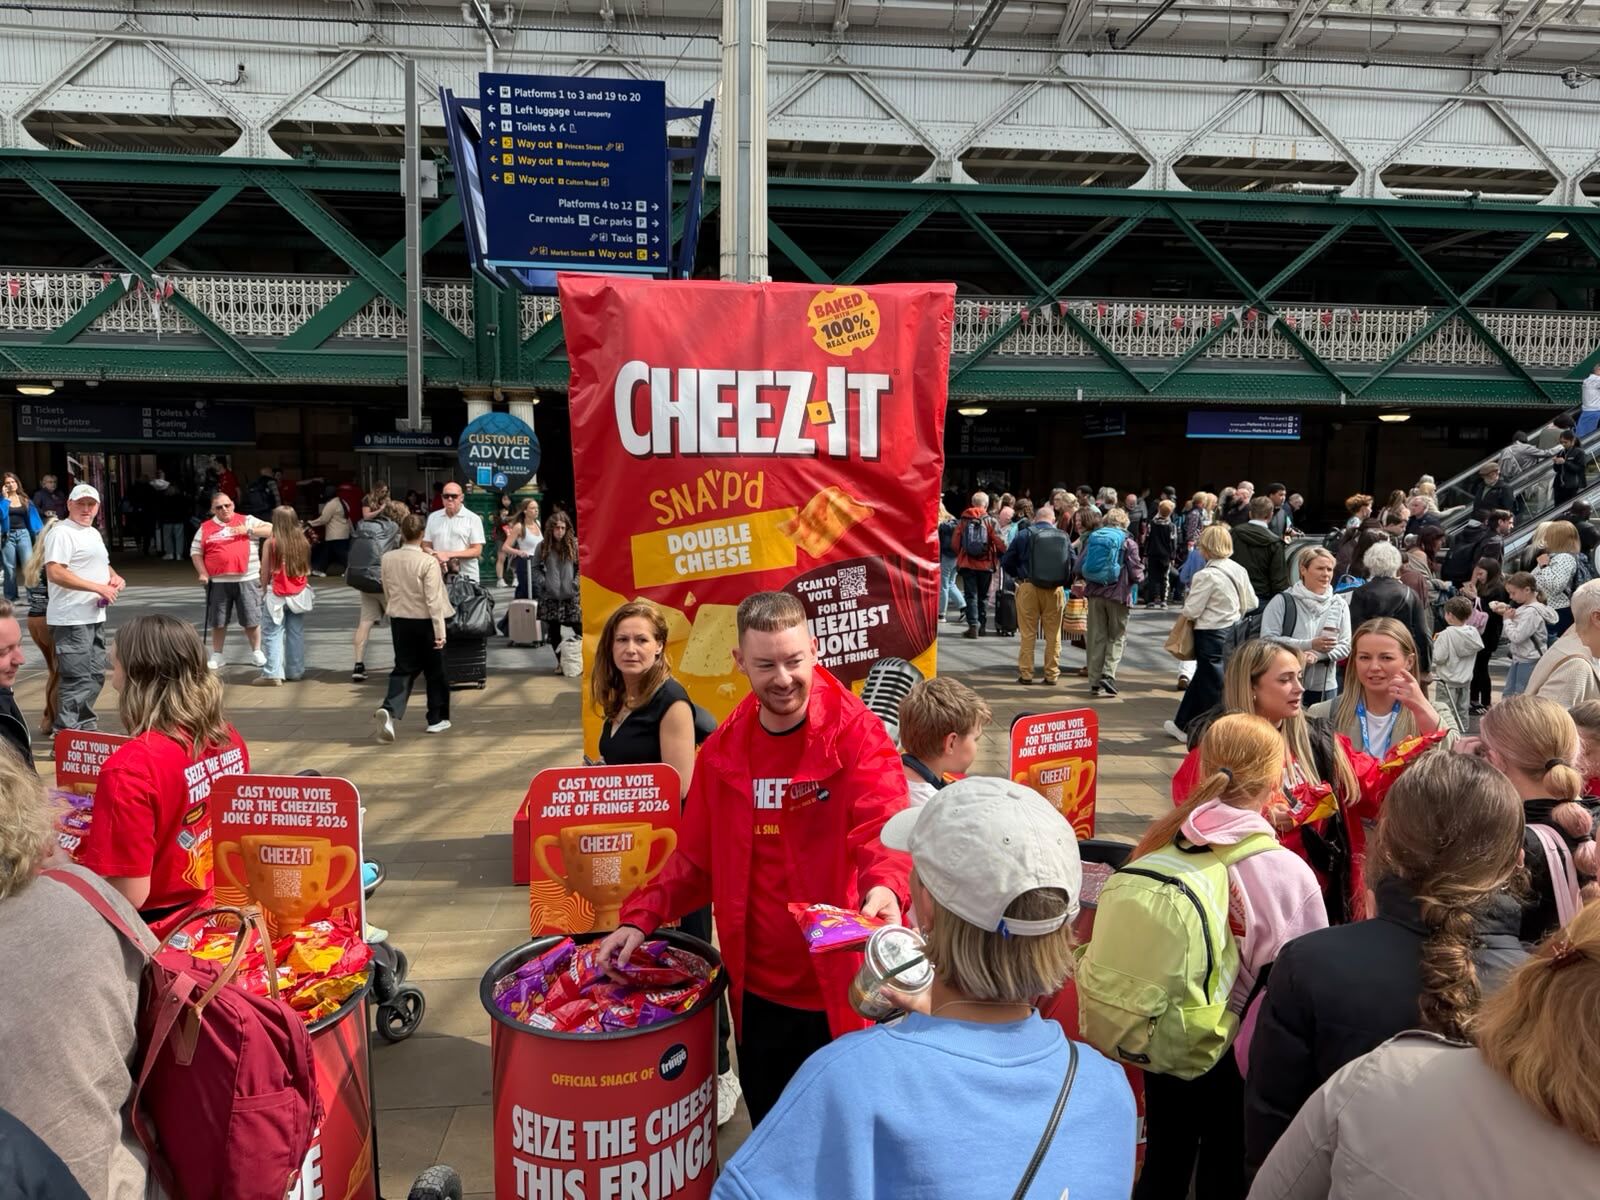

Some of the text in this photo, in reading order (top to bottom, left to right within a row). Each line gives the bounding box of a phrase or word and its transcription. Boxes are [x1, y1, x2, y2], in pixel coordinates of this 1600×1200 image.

[514, 88, 641, 102] Platforms 1 to 3 and 19 to 20
[515, 106, 533, 114] Left
[535, 106, 570, 117] luggage
[516, 122, 546, 131] Toilets
[517, 139, 536, 150] Way
[538, 141, 552, 149] out
[518, 156, 536, 166] Way
[566, 160, 590, 168] Waverley
[518, 175, 538, 185] Way
[559, 199, 632, 210] Platforms 4 to 12
[529, 214, 543, 223] Car
[545, 214, 575, 224] rentals
[593, 216, 608, 225] Car
[610, 217, 632, 227] parks
[611, 233, 633, 242] Taxis
[598, 250, 616, 259] Way
[814, 293, 863, 318] BAKED
[834, 311, 850, 320] WITH
[821, 312, 870, 340] 100%
[826, 328, 875, 349] REAL CHEESE
[34, 406, 64, 414] Tickets
[155, 408, 184, 417] Toilets
[35, 417, 90, 426] Travel Centre
[155, 419, 186, 429] Seating
[156, 429, 216, 439] Cash machines
[373, 435, 440, 445] Rail Information
[468, 434, 530, 445] CUSTOMER
[469, 446, 530, 460] ADVICE
[667, 522, 752, 554] DOUBLE
[675, 545, 751, 576] CHEESE
[797, 576, 837, 592] SCAN TO
[808, 589, 833, 602] VOTE
[818, 599, 858, 615] FOR THE
[817, 630, 869, 657] JOKE
[824, 655, 843, 668] THE
[845, 648, 879, 664] FRINGE
[1029, 718, 1084, 734] CAST YOUR VOTE
[1025, 728, 1087, 746] FOR THE CHEEZIEST
[71, 739, 88, 751] CAST
[89, 742, 110, 754] YOUR
[1018, 738, 1092, 759] JOKE OF FRINGE 2026
[68, 751, 82, 761] FOR
[83, 753, 96, 764] THE
[62, 762, 80, 773] JOKE
[82, 764, 91, 775] OF
[184, 748, 242, 787] SEIZE THE CHEESE
[558, 774, 654, 790] CAST YOUR VOTE
[1040, 766, 1072, 785] CHEEZ-IT
[189, 777, 211, 804] THIS
[237, 786, 331, 801] CAST YOUR VOTE
[552, 787, 660, 804] FOR THE CHEEZIEST
[232, 800, 338, 814] FOR THE CHEEZIEST
[541, 800, 670, 818] JOKE OF FRINGE 2026
[222, 812, 348, 828] JOKE OF FRINGE 2026
[580, 834, 633, 853] CHEEZ-IT
[260, 845, 312, 865] CHEEZ-IT
[661, 1050, 687, 1074] fringe
[552, 1067, 654, 1087] OFFICIAL SNACK OF
[512, 1073, 713, 1161] SEIZE THE CHEESE
[512, 1110, 713, 1200] THIS FRINGE
